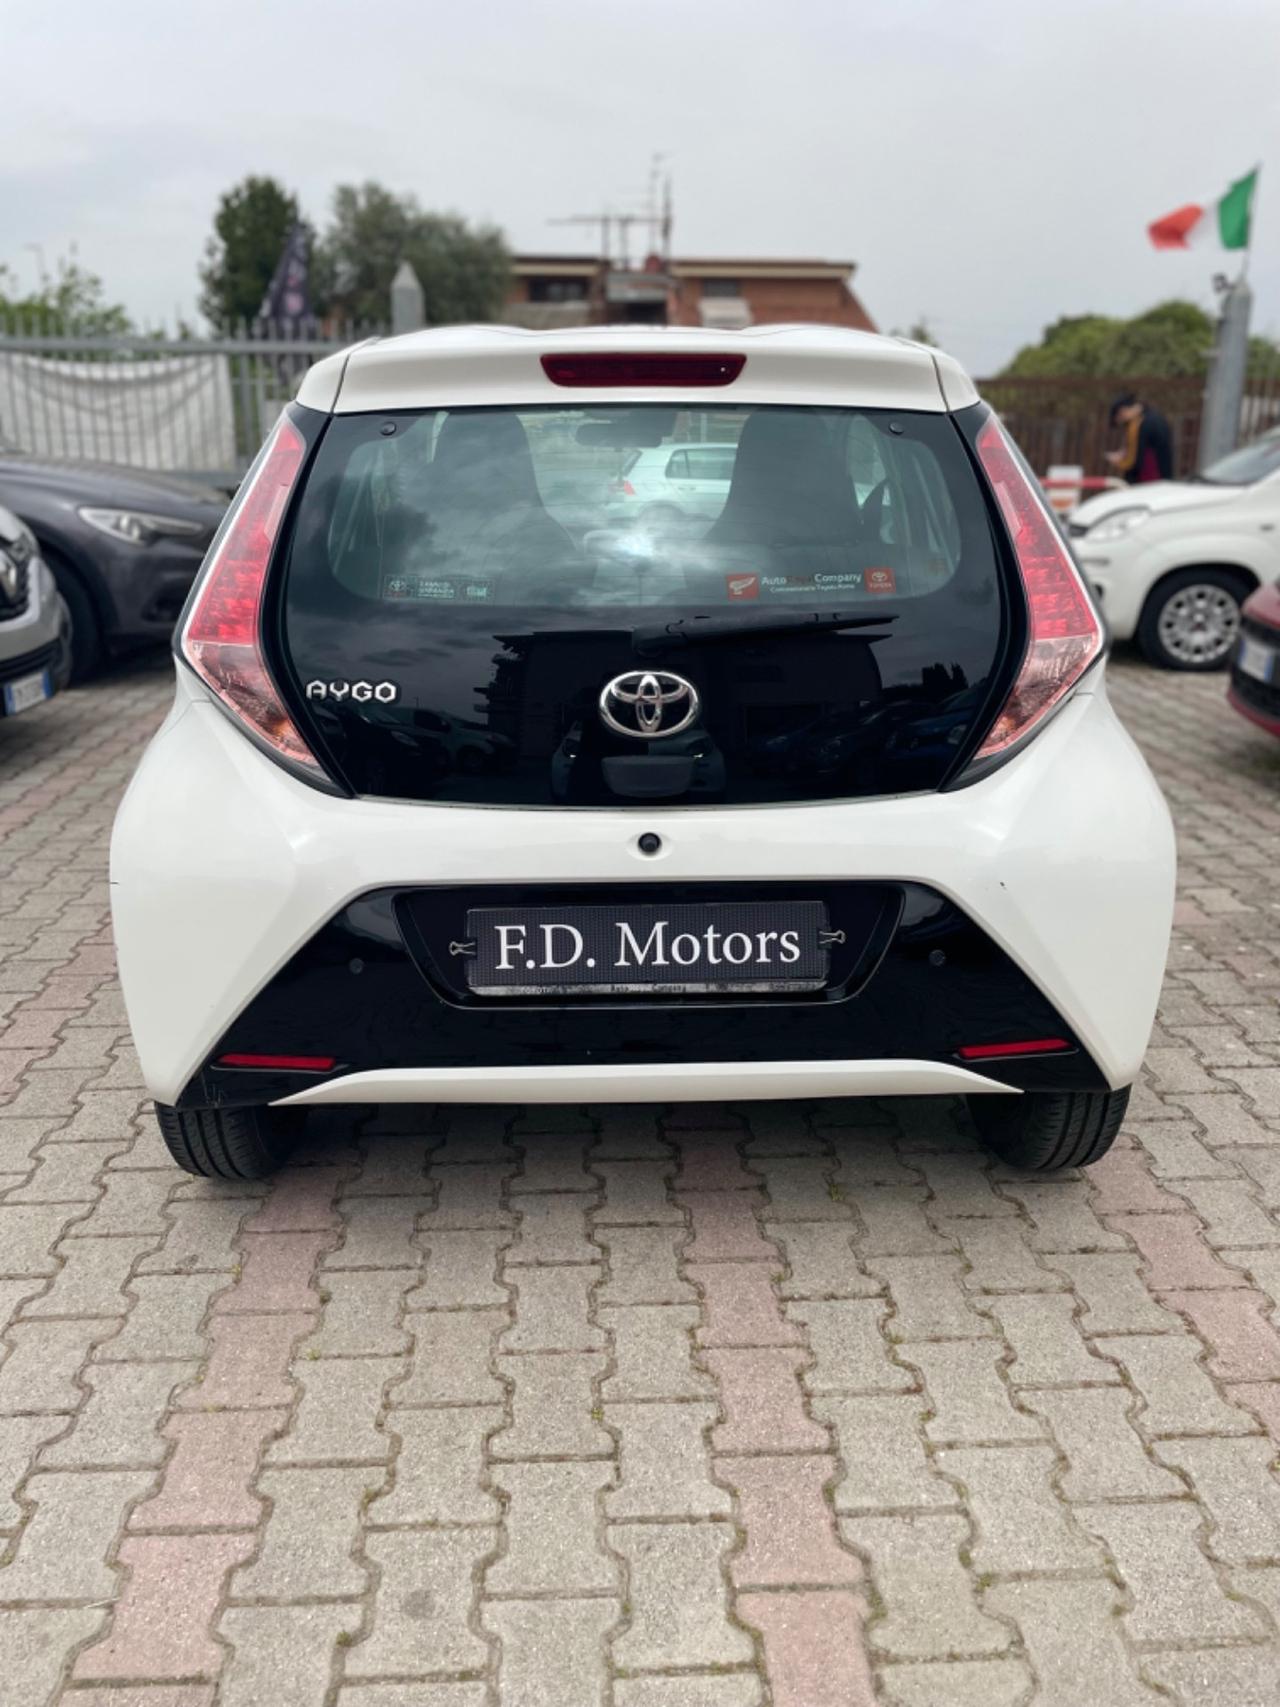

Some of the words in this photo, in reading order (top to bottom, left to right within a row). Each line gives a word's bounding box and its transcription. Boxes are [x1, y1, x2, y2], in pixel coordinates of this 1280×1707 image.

[305, 680, 397, 703] AYGO
[493, 923, 597, 970] F.D.
[614, 921, 802, 968] Motors
